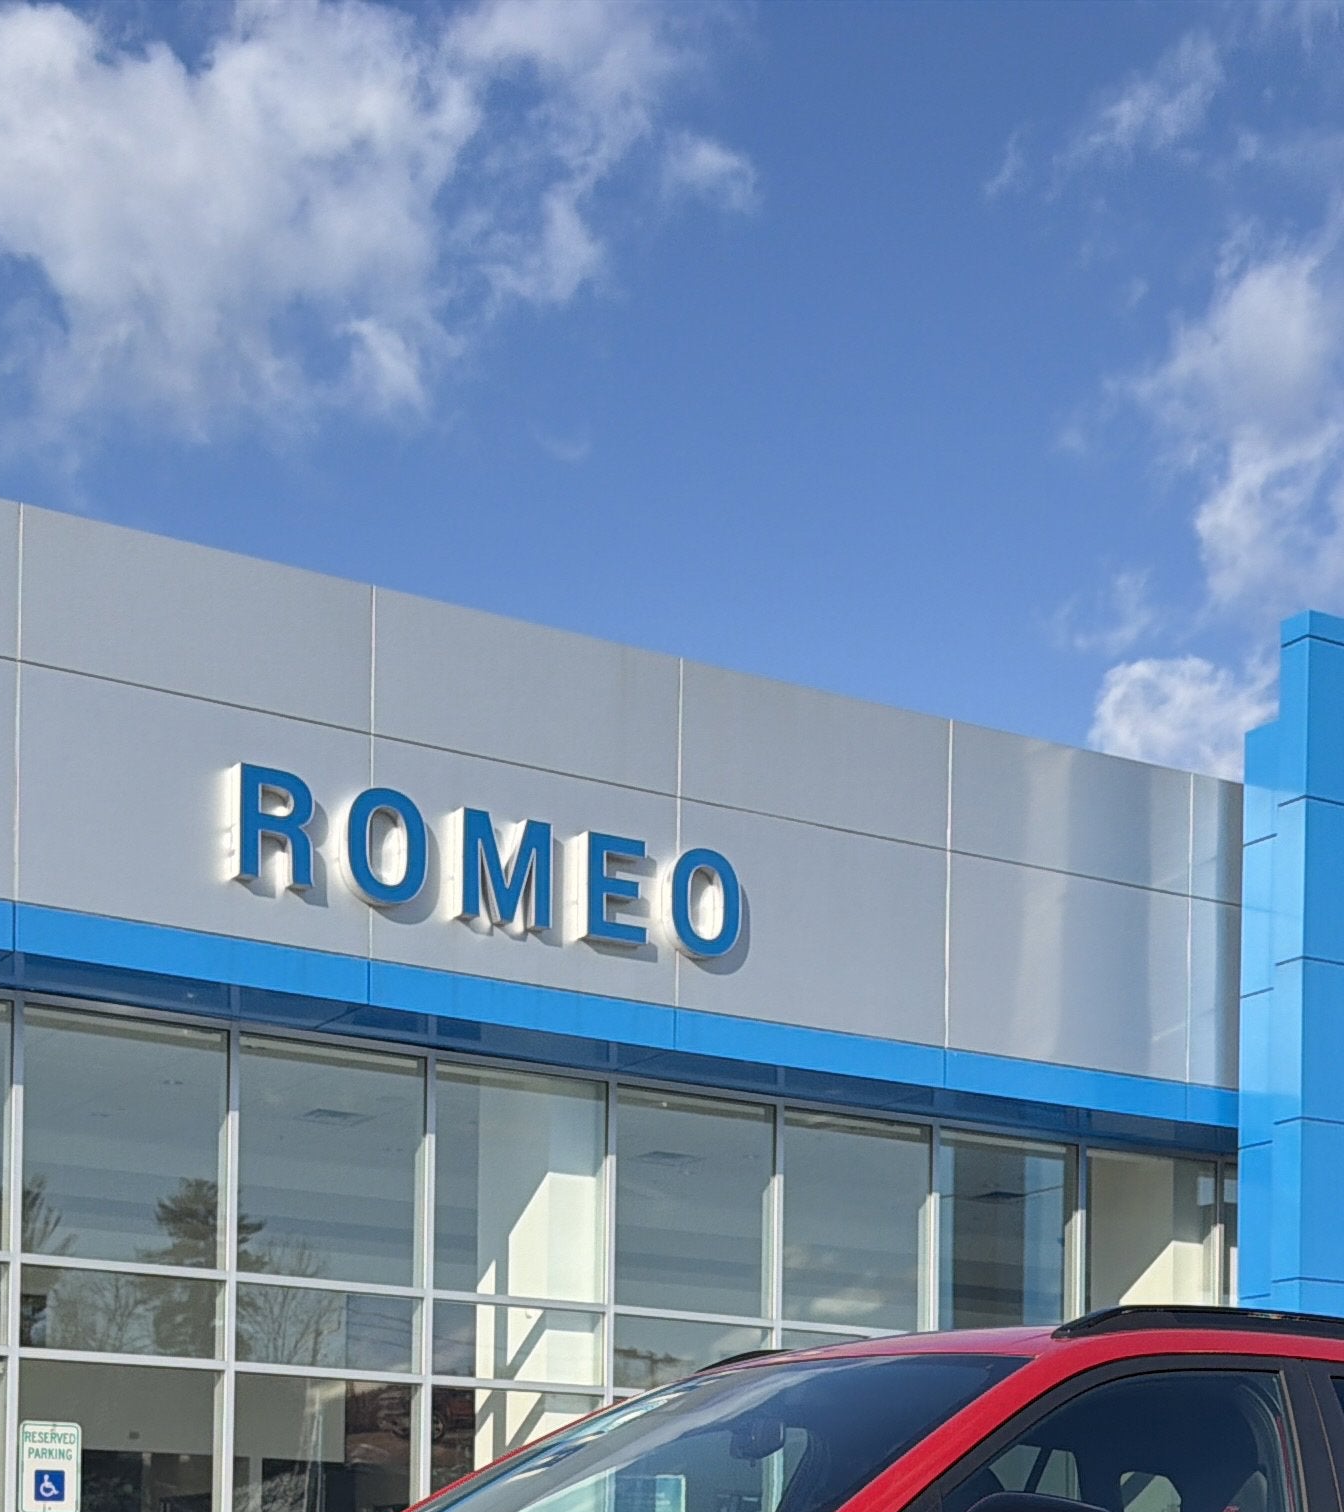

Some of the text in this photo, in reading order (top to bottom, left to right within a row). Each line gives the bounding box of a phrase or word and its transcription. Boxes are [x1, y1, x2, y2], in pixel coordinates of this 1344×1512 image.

[234, 761, 743, 960] ROMEO
[23, 1430, 76, 1445] RESERVED
[27, 1447, 73, 1461] PARKING
